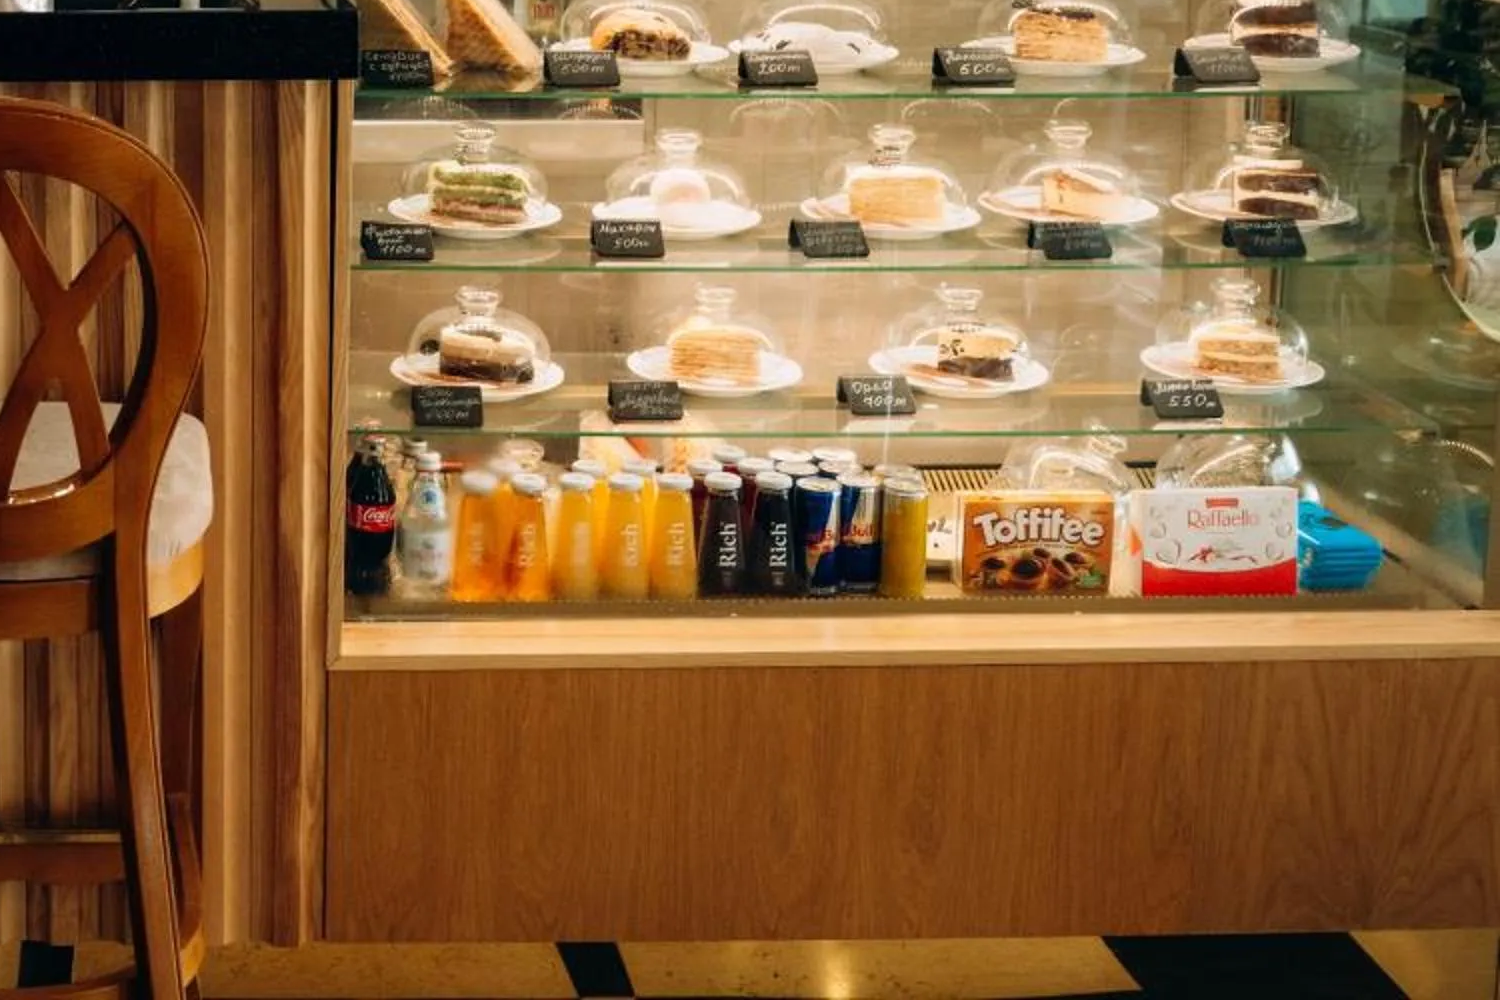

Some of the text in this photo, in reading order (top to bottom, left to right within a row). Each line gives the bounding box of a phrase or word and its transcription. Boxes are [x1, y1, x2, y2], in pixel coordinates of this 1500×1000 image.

[973, 506, 1105, 547] Toffifee
[1187, 508, 1261, 531] Raffaello
[719, 522, 737, 567] Rich
[769, 522, 787, 567] Rich
